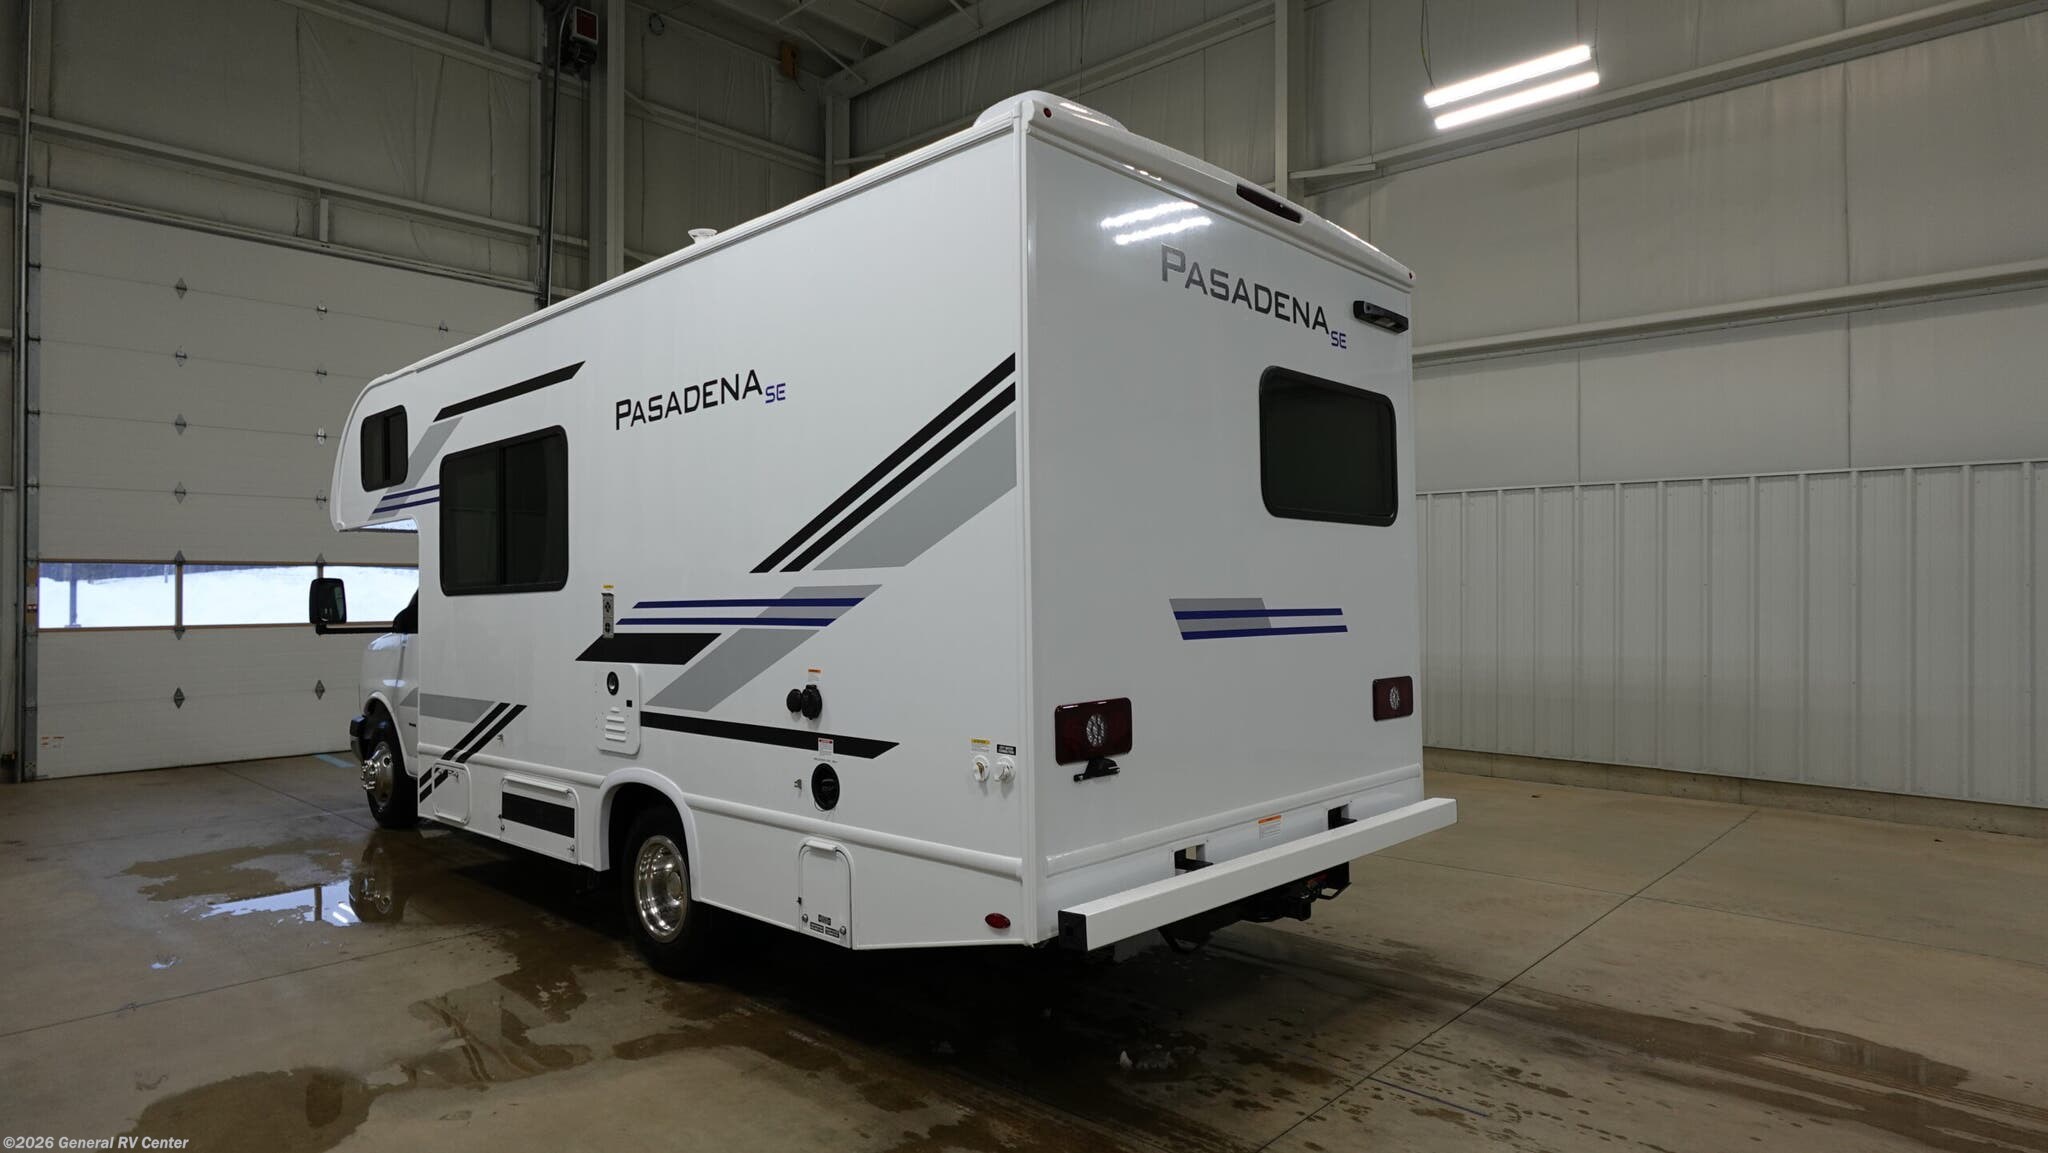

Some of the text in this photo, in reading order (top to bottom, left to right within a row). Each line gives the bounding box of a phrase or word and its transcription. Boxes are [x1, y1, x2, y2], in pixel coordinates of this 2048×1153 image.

[1161, 242, 1348, 350] PASADENA SE
[616, 369, 787, 430] PASADENA SE
